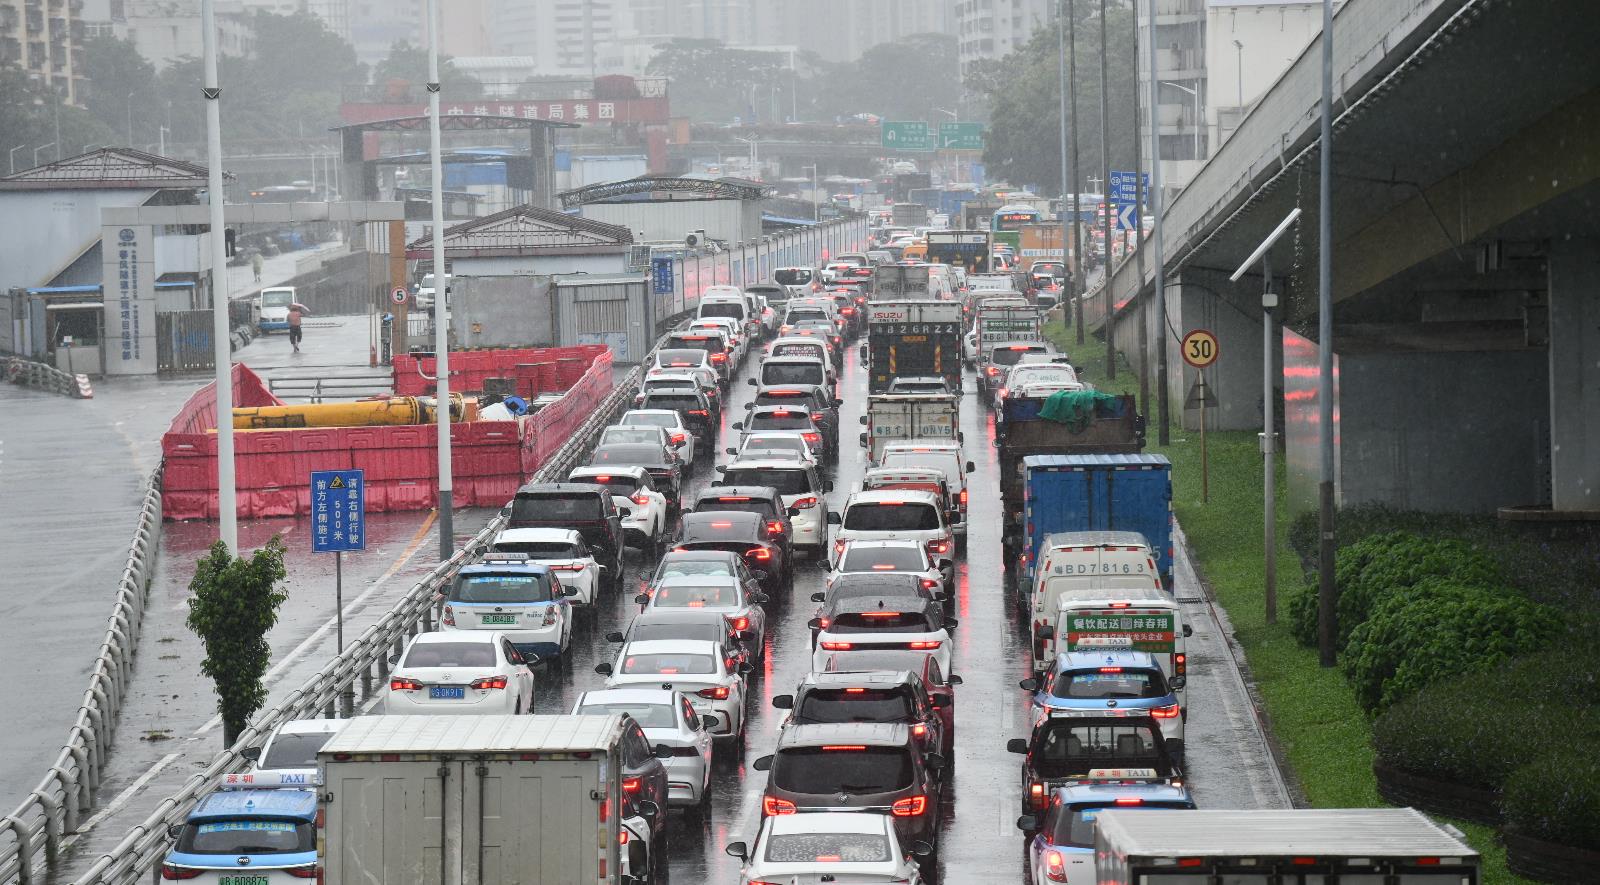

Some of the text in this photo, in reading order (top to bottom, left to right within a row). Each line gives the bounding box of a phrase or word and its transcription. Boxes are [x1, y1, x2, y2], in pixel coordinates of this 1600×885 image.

[396, 290, 404, 300] 5
[1189, 339, 1211, 359] 30
[317, 480, 328, 545] 前方左侧施工
[334, 501, 343, 541] 500米
[348, 479, 359, 544] 请靠右侧行驶
[1073, 617, 1168, 630] 餐饮配送 绿春翔
[226, 774, 305, 784] 深圳 TAXI
